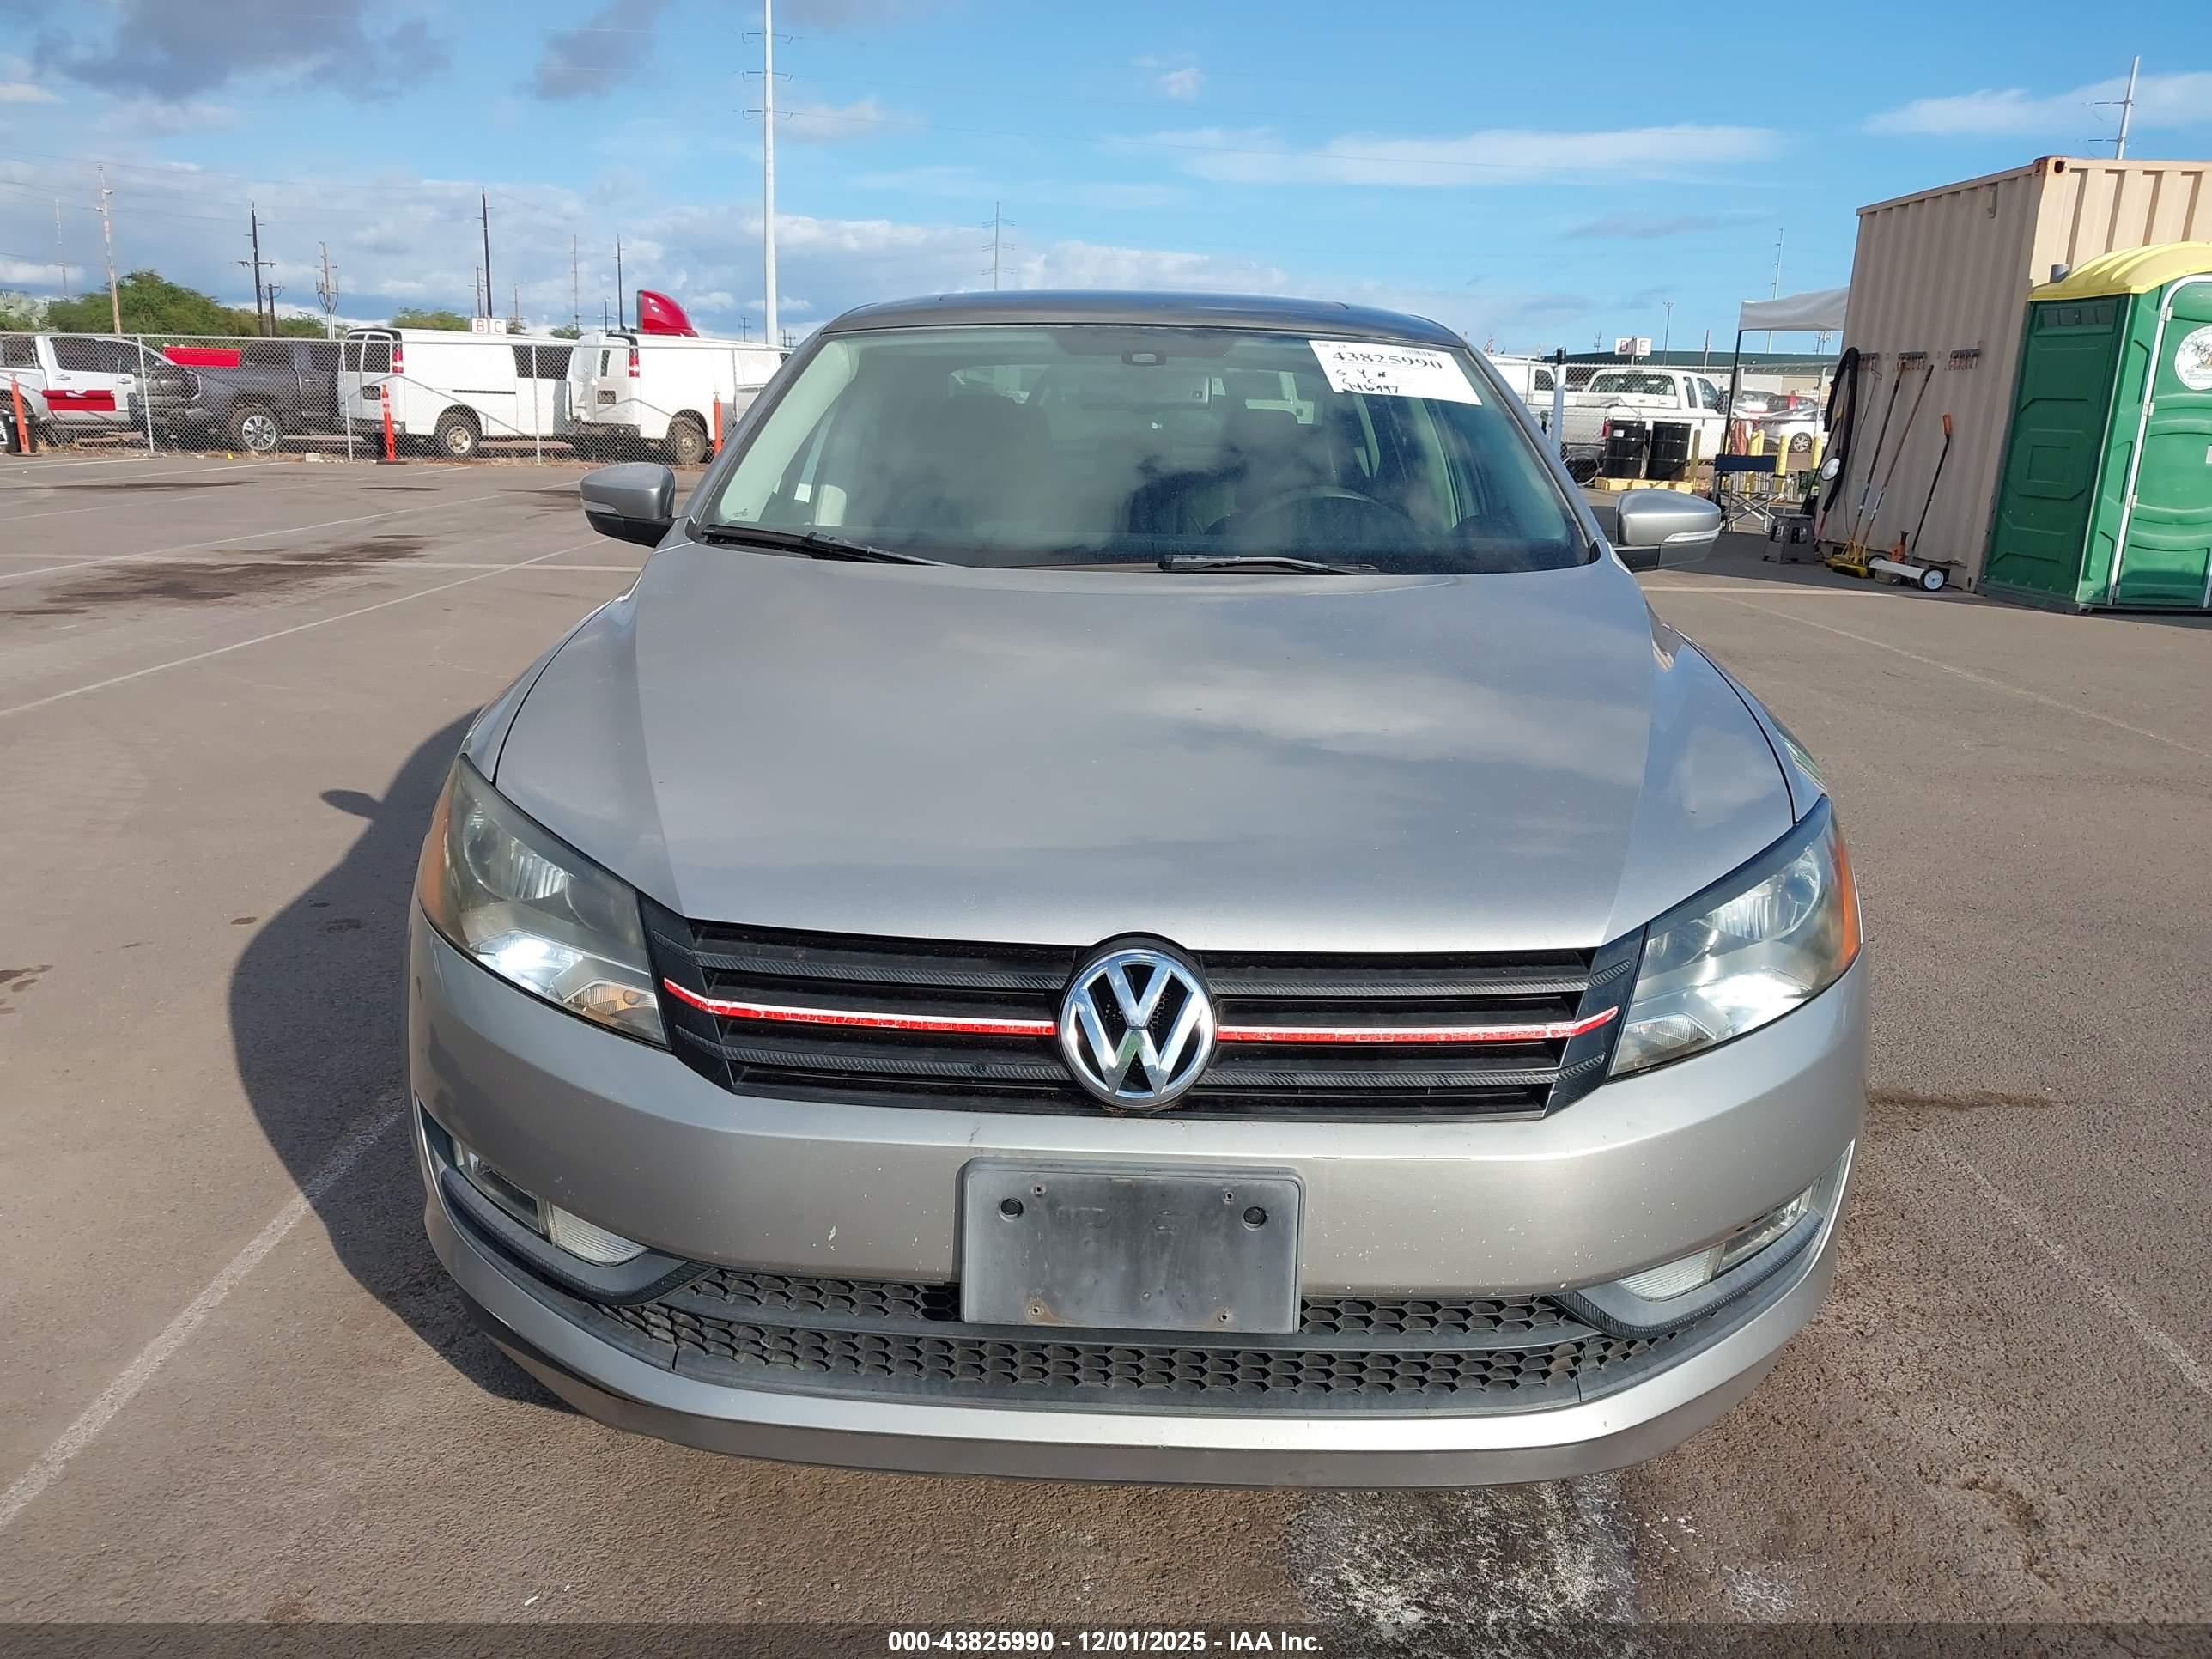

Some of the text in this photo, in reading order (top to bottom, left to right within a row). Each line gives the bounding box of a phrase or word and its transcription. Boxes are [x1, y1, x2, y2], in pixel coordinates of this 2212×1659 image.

[477, 319, 484, 332] B
[494, 320, 502, 333] C
[1620, 340, 1628, 352] D
[1639, 340, 1648, 352] E
[1332, 351, 1443, 370] 43825990
[1065, 955, 1212, 1103] VW
